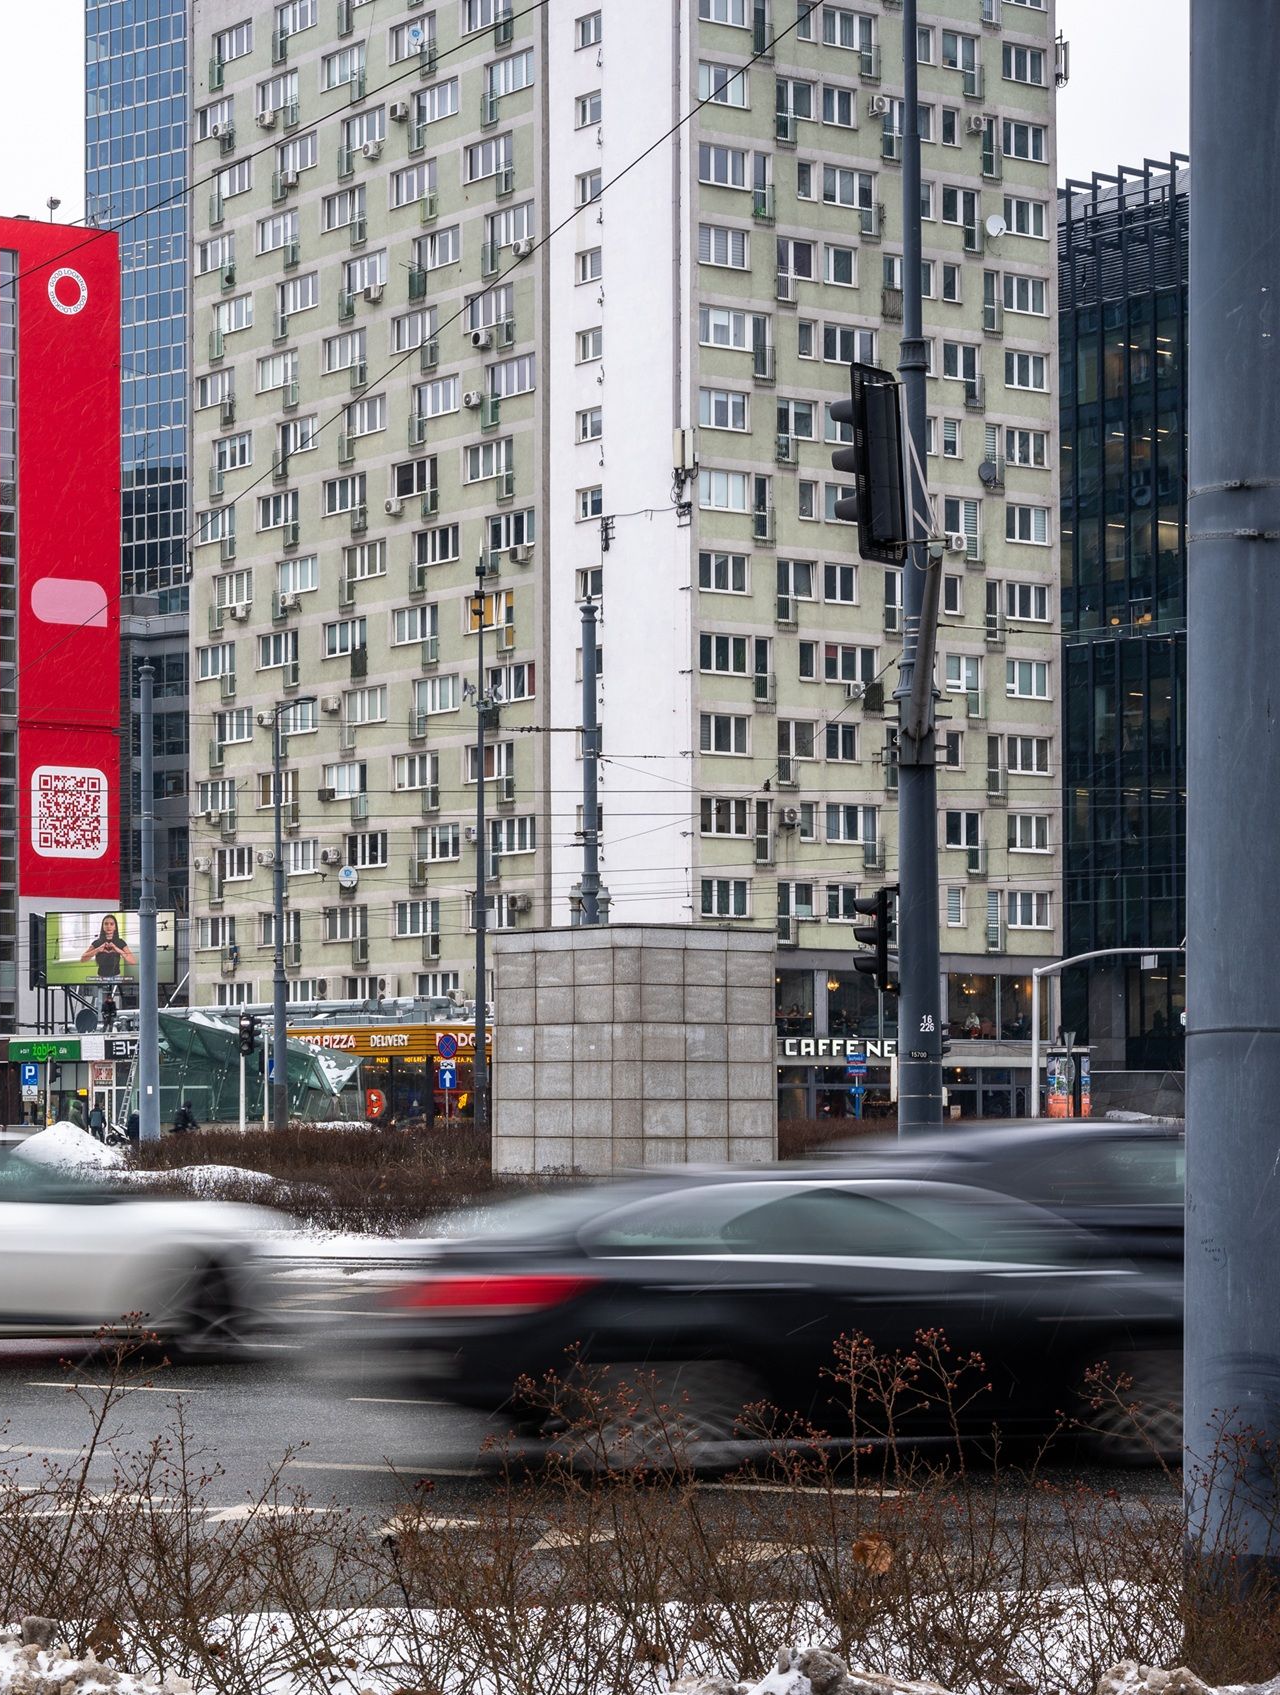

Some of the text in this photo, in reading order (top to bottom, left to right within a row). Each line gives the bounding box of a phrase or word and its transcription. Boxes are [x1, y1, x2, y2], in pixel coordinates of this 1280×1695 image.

[50, 269, 86, 292] GOOD LOOKING
[922, 1014, 933, 1023] 16
[920, 1022, 935, 1032] 226
[322, 1035, 356, 1048] PIZZA
[370, 1034, 409, 1047] DELIVERY
[866, 1040, 897, 1057] NE
[25, 1066, 35, 1079] P
